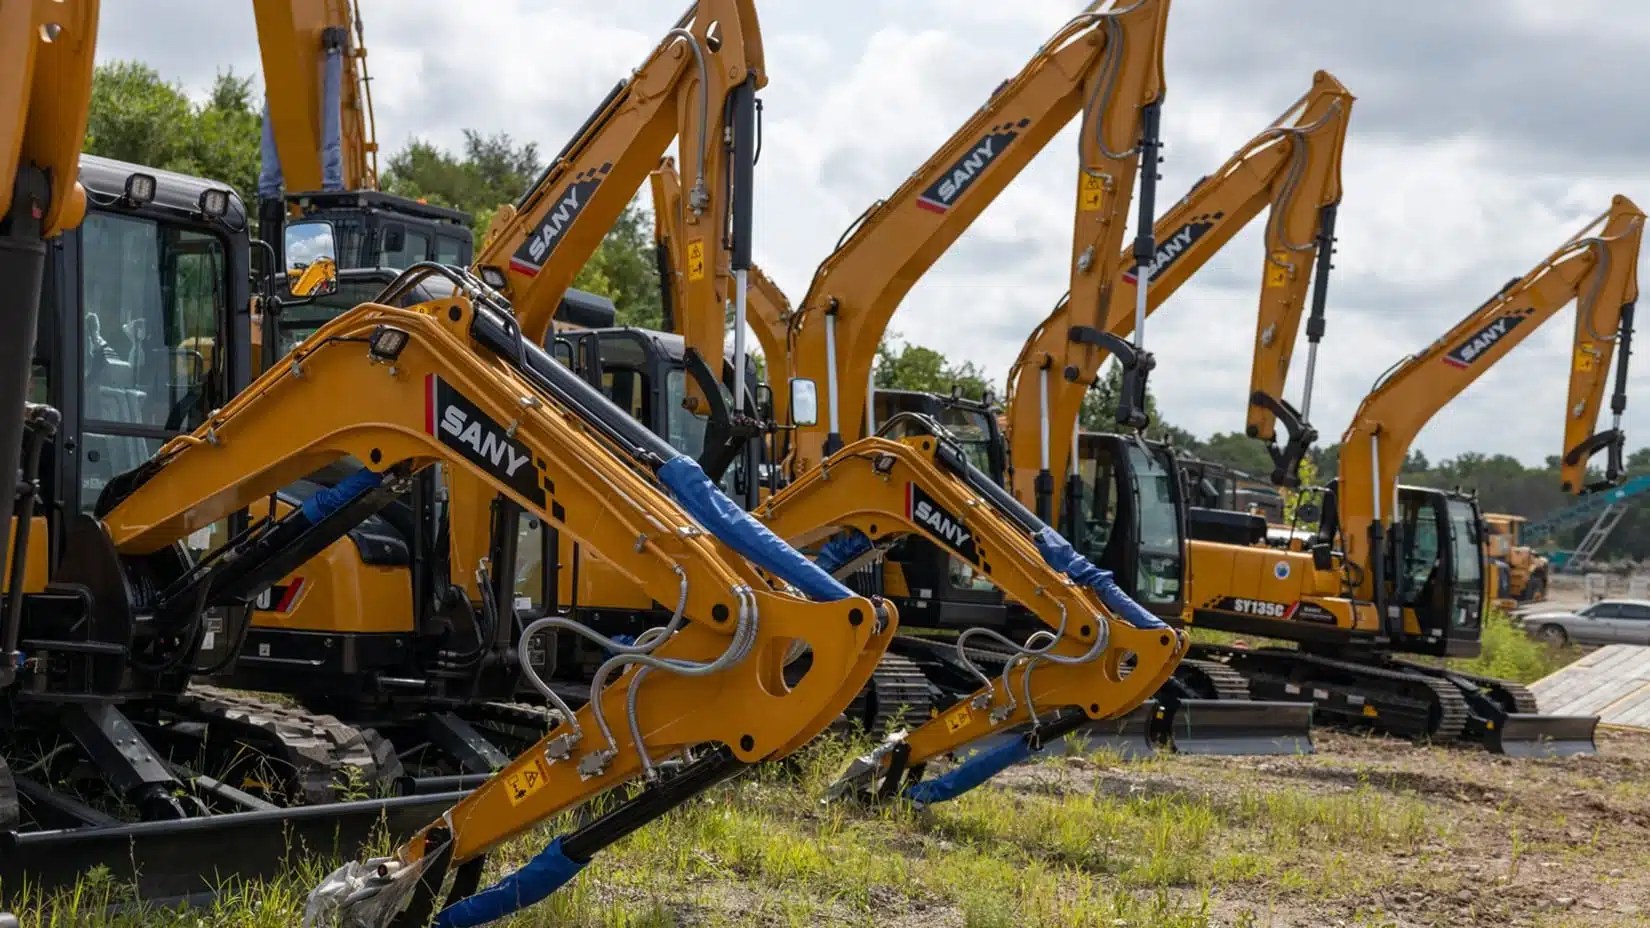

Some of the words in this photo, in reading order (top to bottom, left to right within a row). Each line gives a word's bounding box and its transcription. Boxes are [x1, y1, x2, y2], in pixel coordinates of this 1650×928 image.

[938, 137, 994, 203] SANY
[528, 186, 579, 262] SANY
[1460, 318, 1507, 361] SANY
[440, 404, 530, 478] SANY
[914, 500, 971, 547] SANY
